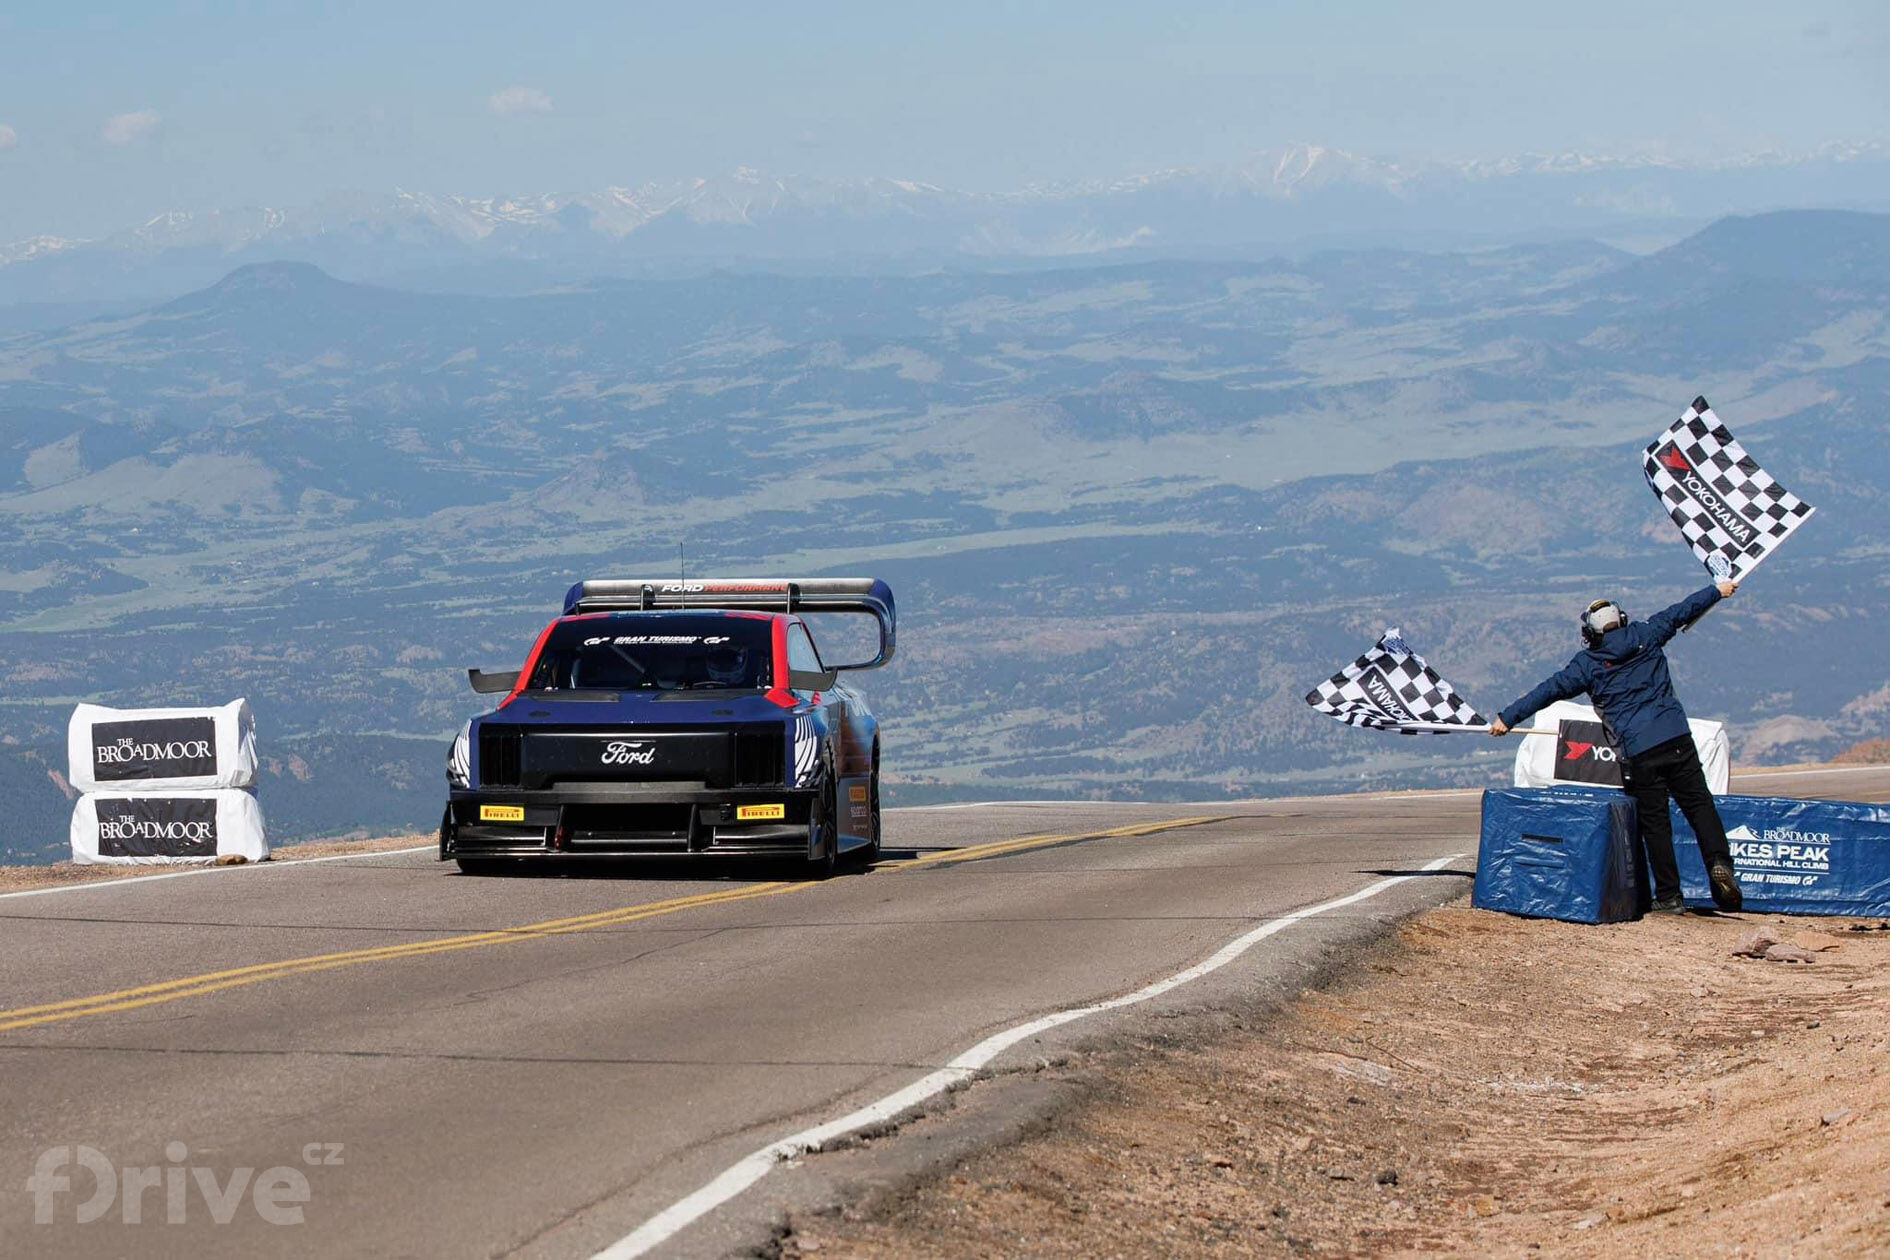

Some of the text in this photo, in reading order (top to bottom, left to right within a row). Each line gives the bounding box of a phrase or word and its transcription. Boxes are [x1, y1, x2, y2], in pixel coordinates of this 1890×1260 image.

[1681, 471, 1751, 542] YOKOHAMA
[661, 583, 788, 592] FORD PERFORMANC
[613, 636, 648, 644] GRAN
[648, 636, 697, 644] TURISMO
[117, 738, 134, 746] THE
[97, 741, 212, 763] BROADMOOR
[600, 742, 656, 765] Ford
[484, 807, 521, 818] PIRELLI
[741, 806, 781, 817] PIRELLI
[119, 815, 136, 823] THE
[99, 821, 213, 840] BROADMOOR
[1763, 829, 1830, 843] BROADMOOR
[1729, 843, 1830, 861] IKES PEAK
[1783, 860, 1801, 869] HILL
[1802, 861, 1829, 870] CLIMB
[1740, 872, 1765, 883] GRAN
[1766, 874, 1801, 885] TURISMO
